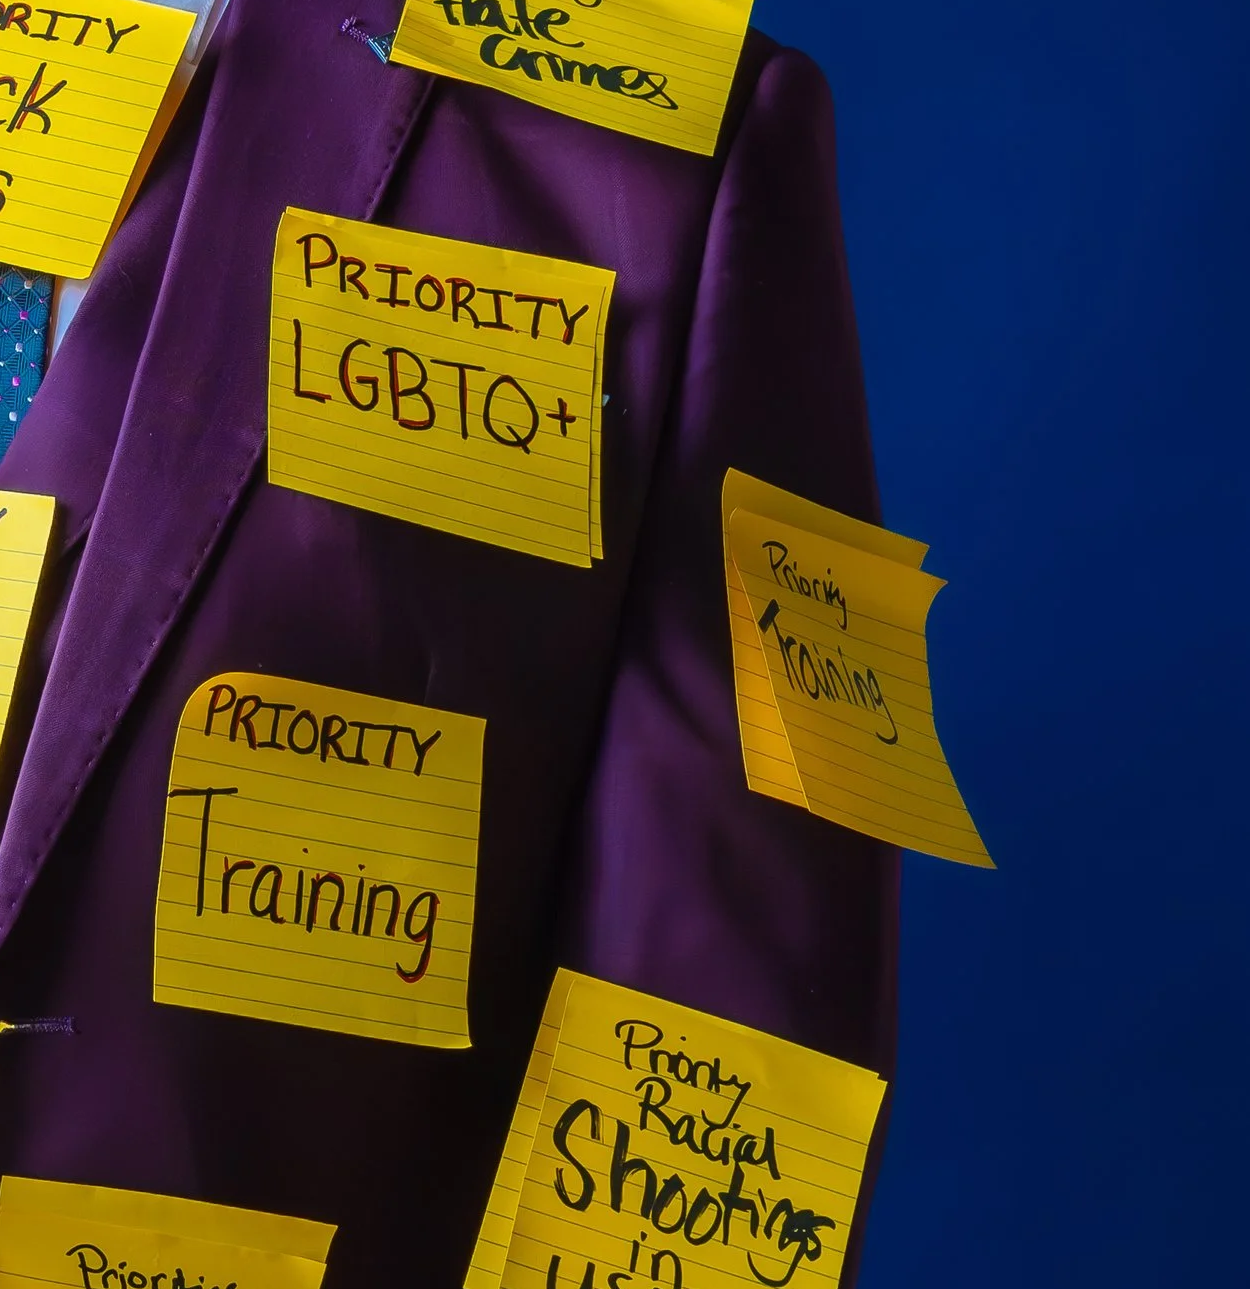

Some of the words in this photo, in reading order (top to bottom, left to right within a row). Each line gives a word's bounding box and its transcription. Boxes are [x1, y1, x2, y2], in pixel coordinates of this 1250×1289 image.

[479, 33, 679, 110] Crimes
[296, 233, 589, 345] PRIORITY
[293, 318, 576, 455] LGBTQ+
[761, 540, 848, 631] Priority
[758, 599, 898, 745] Training
[205, 684, 441, 776] PRIORITY
[167, 787, 440, 983] Training
[614, 1019, 751, 1129] Priority
[635, 1076, 781, 1180] Racial
[553, 1098, 836, 1288] Shootings
